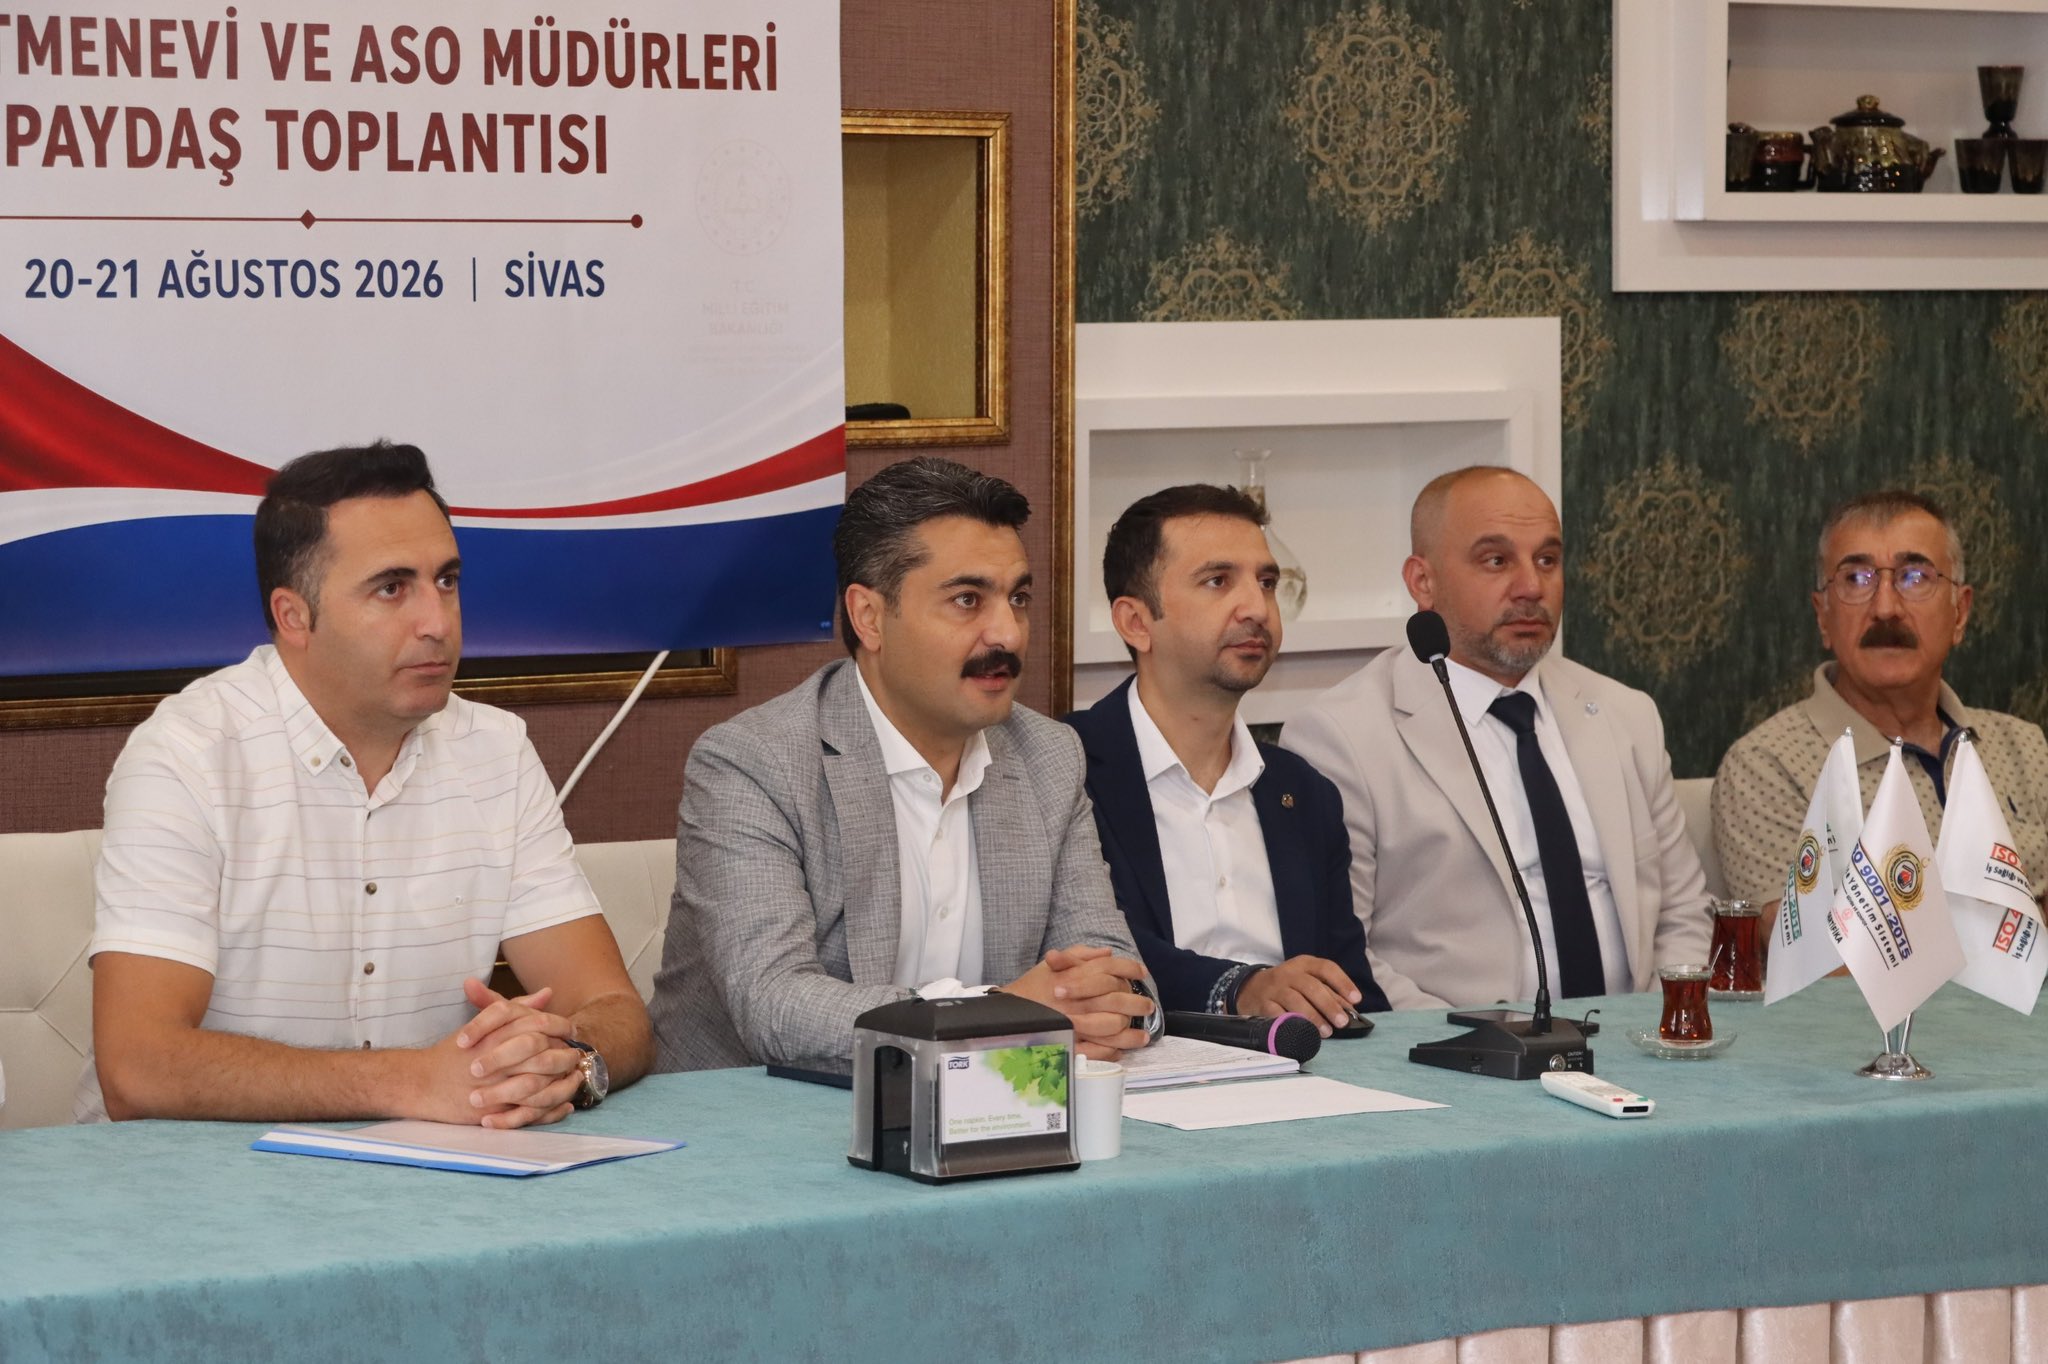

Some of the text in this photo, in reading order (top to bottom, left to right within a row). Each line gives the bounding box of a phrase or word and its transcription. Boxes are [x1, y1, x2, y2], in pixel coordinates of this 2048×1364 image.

[0, 6, 777, 91] MENEVİ VE ASO MÜDÜRLERİ
[6, 104, 607, 187] PAYDAŞ TOPLANTISI
[25, 249, 605, 299] 20-21 AĞUSTOS 2026 SİVAS
[1991, 843, 2019, 867] ISO
[1860, 865, 1890, 907] 9001
[1848, 877, 1900, 968] Yönetim Sistemi
[1995, 921, 2016, 953] ISO
[948, 1059, 970, 1071] TORK
